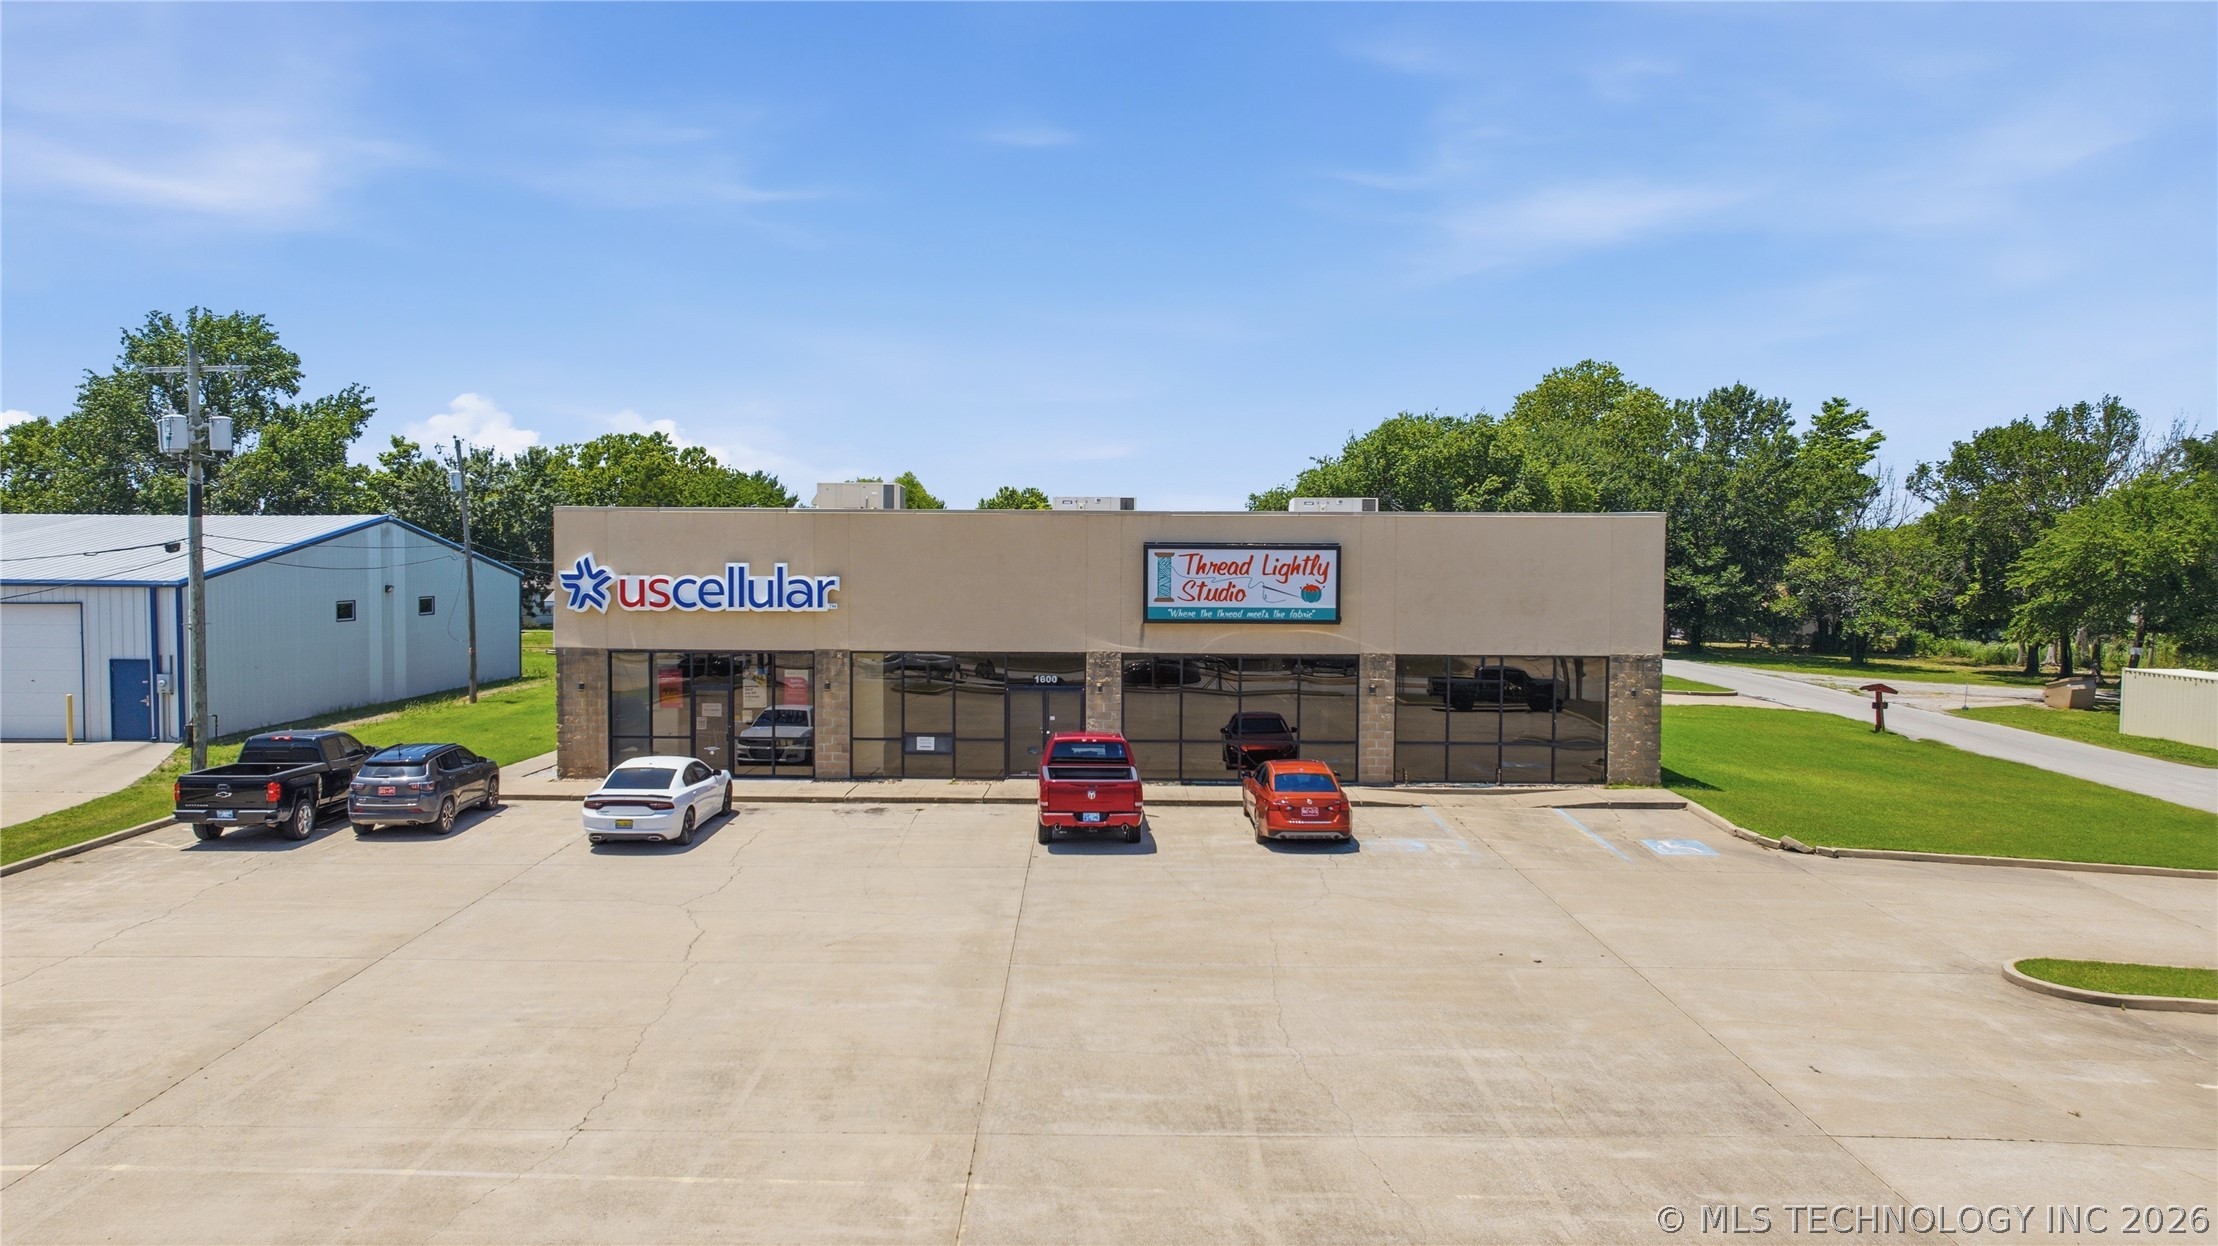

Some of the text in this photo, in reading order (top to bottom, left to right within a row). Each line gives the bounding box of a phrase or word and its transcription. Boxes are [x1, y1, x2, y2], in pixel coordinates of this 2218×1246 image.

[1178, 552, 1330, 584] Thread Lightly
[618, 564, 838, 610] uscellular
[1177, 579, 1247, 602] Studio
[1200, 608, 1213, 618] the
[1216, 608, 1244, 618] thread
[1246, 609, 1269, 618] meets
[1273, 609, 1286, 618] the
